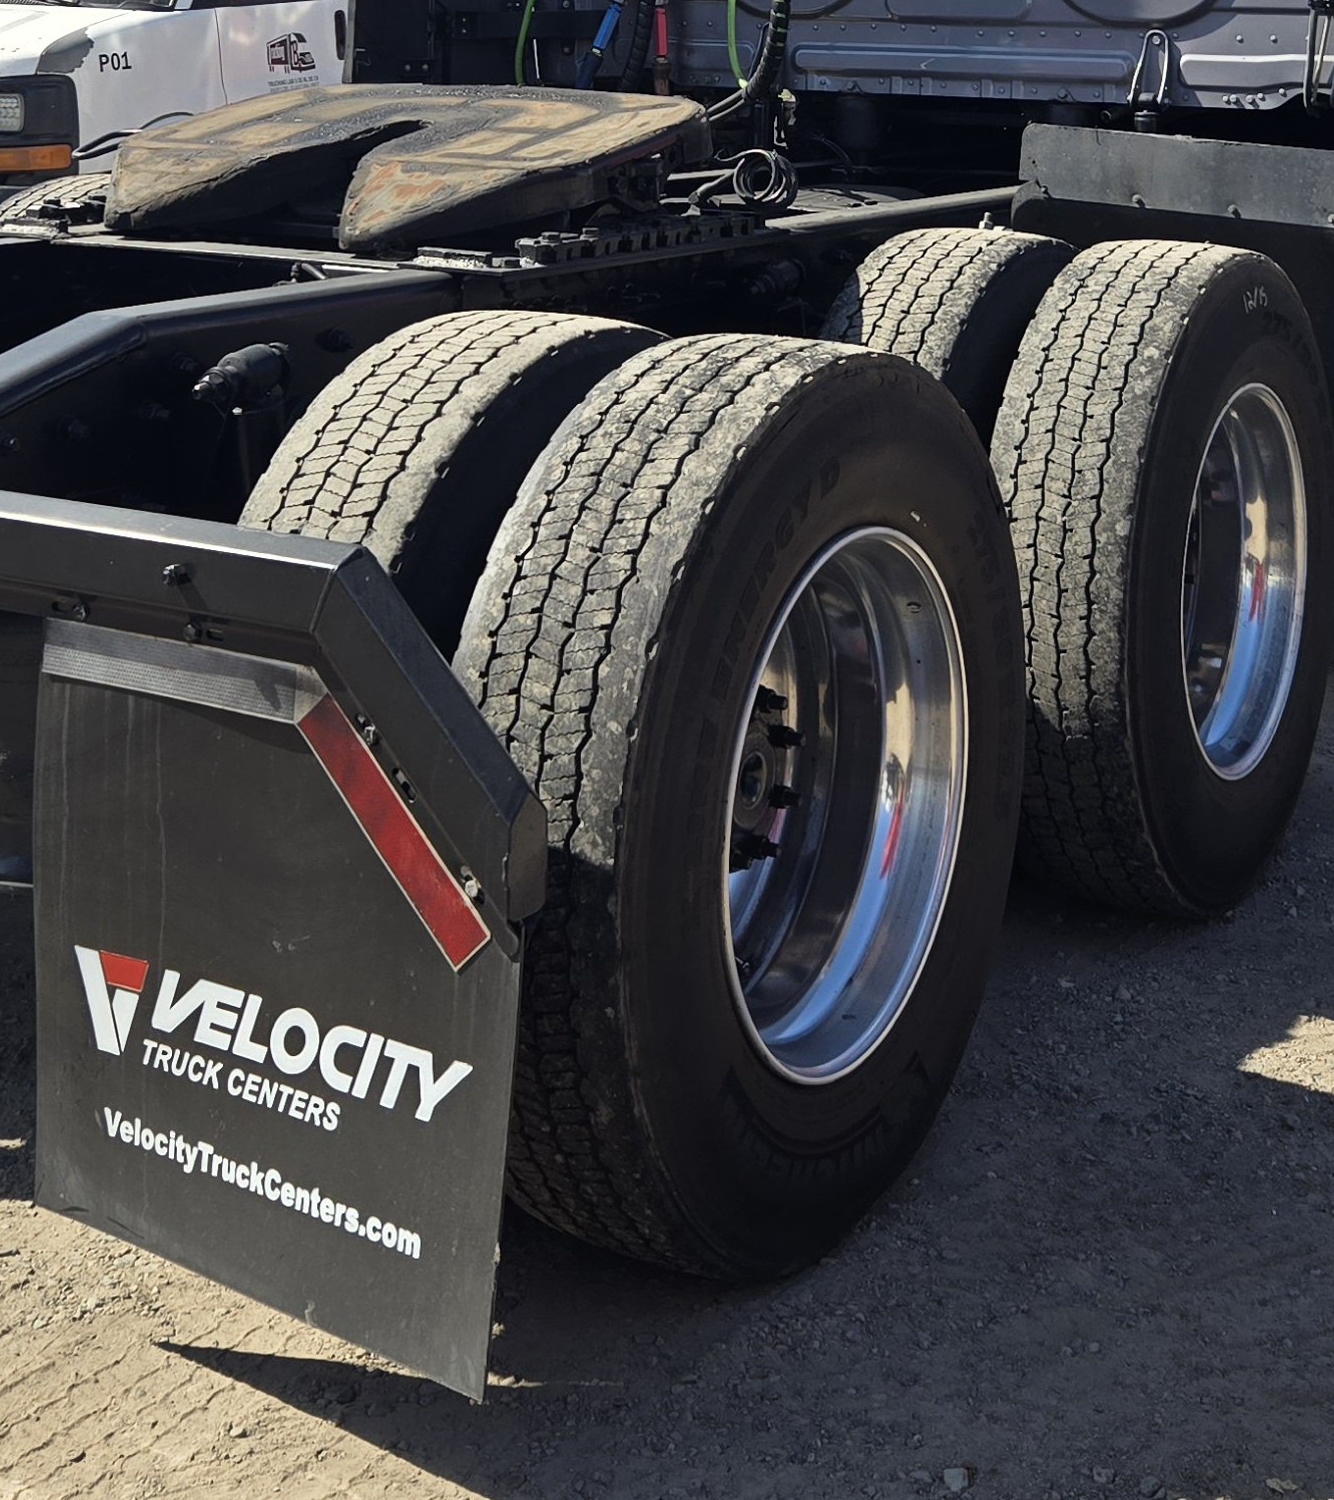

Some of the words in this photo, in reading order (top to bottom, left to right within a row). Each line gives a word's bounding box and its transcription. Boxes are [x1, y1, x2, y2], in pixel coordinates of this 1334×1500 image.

[98, 51, 133, 72] P01
[141, 1038, 224, 1091] TRUCK
[227, 1068, 342, 1132] CENTERS
[151, 968, 474, 1123] VELOCITY
[102, 1106, 422, 1260] VelocityTruckCenters.com
